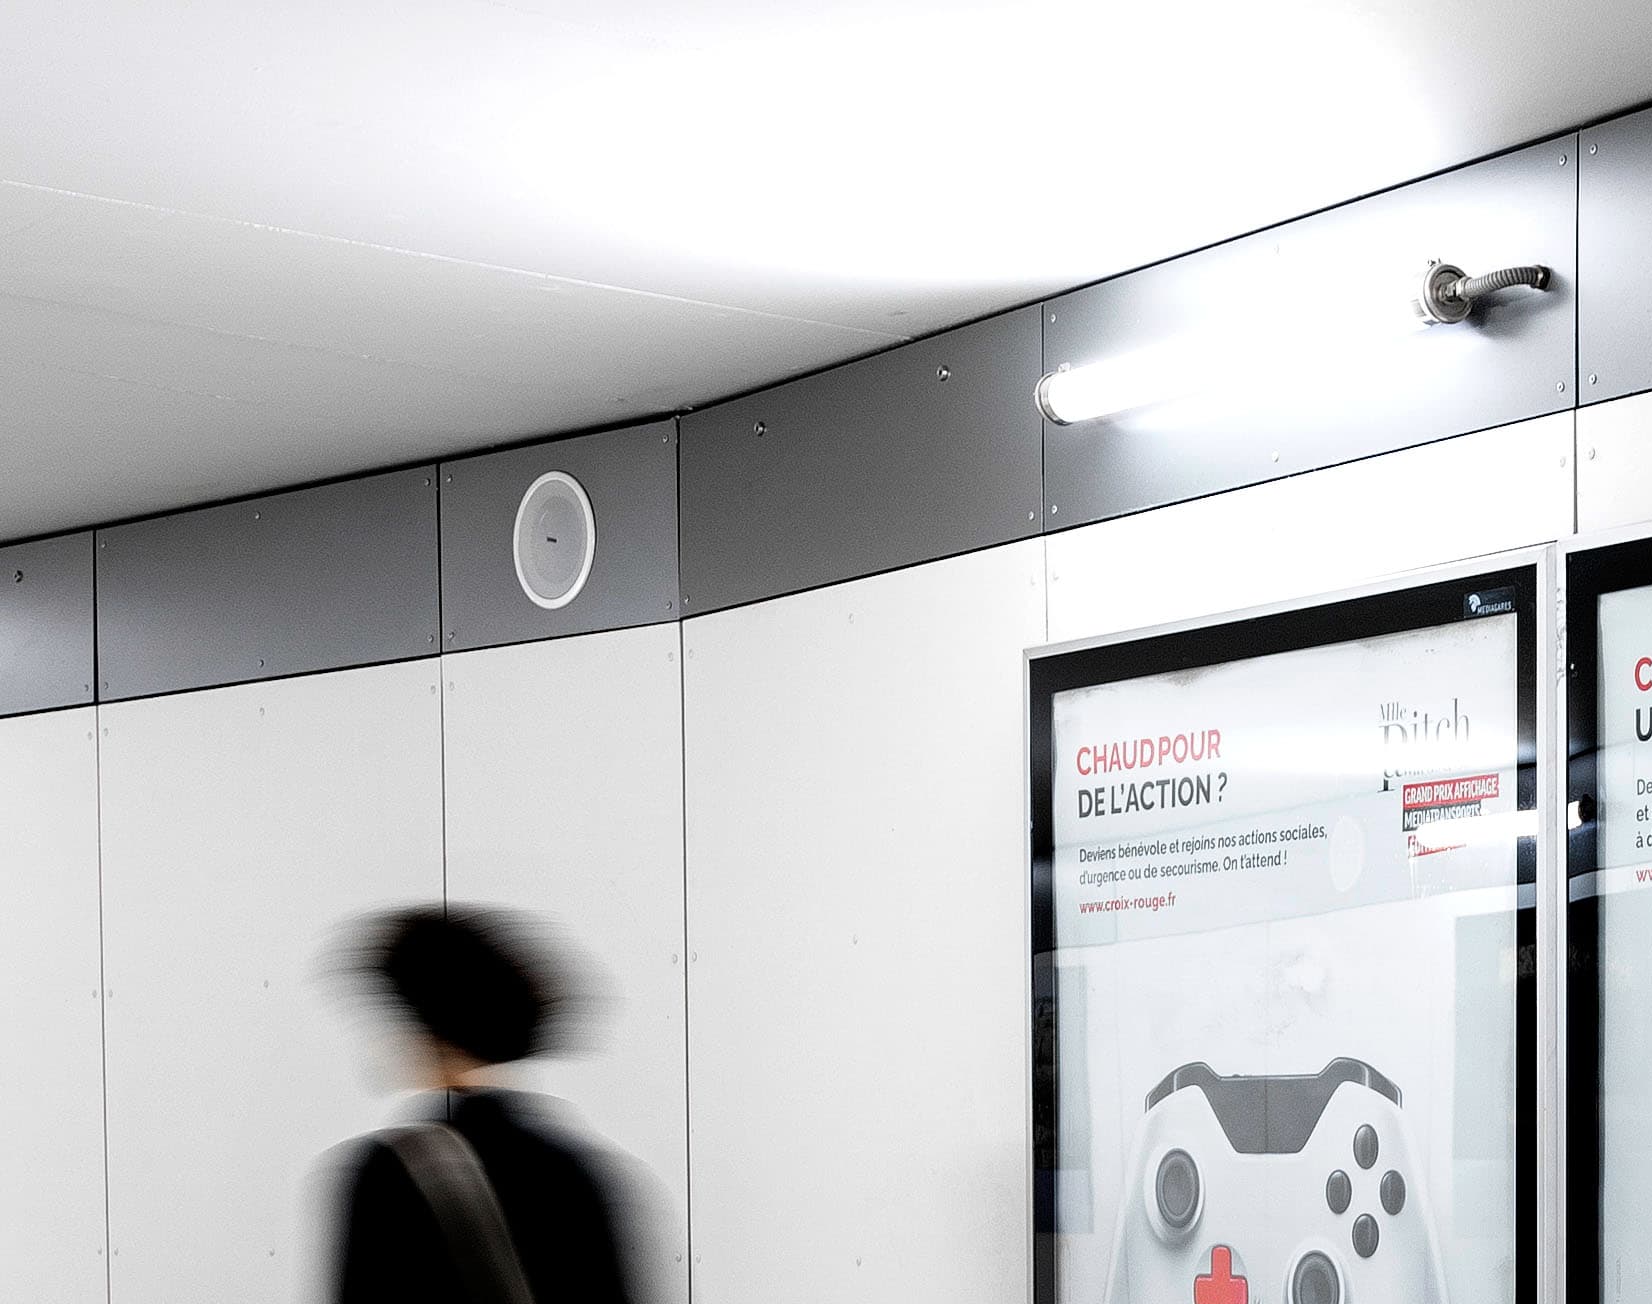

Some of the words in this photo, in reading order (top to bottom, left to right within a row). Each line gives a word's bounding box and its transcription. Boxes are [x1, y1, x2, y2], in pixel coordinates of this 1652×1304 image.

[1076, 738, 1155, 775] CHAUD
[1158, 729, 1221, 766] POUR
[1078, 787, 1105, 818] DE
[1110, 774, 1211, 814] L'ACTION
[1404, 786, 1432, 804] GRAND
[1433, 784, 1453, 801] PRIX
[1454, 777, 1497, 799] AFFICHAGE
[1636, 805, 1649, 821] et
[1079, 846, 1116, 862] Deviens
[1118, 840, 1167, 858] bénévole
[1169, 839, 1180, 853] et
[1181, 835, 1215, 855] rejoins
[1218, 836, 1236, 848] nos
[1239, 829, 1278, 846] actions
[1280, 823, 1328, 842] sociales,
[1636, 831, 1644, 848] à
[1079, 870, 1126, 887] d'urgence
[1128, 868, 1141, 880] ou
[1143, 863, 1158, 878] de
[1160, 859, 1221, 877] secourisme.
[1223, 856, 1238, 871] On
[1240, 850, 1281, 869] t'attend
[1079, 891, 1176, 914] www.croix-rouge.fr
